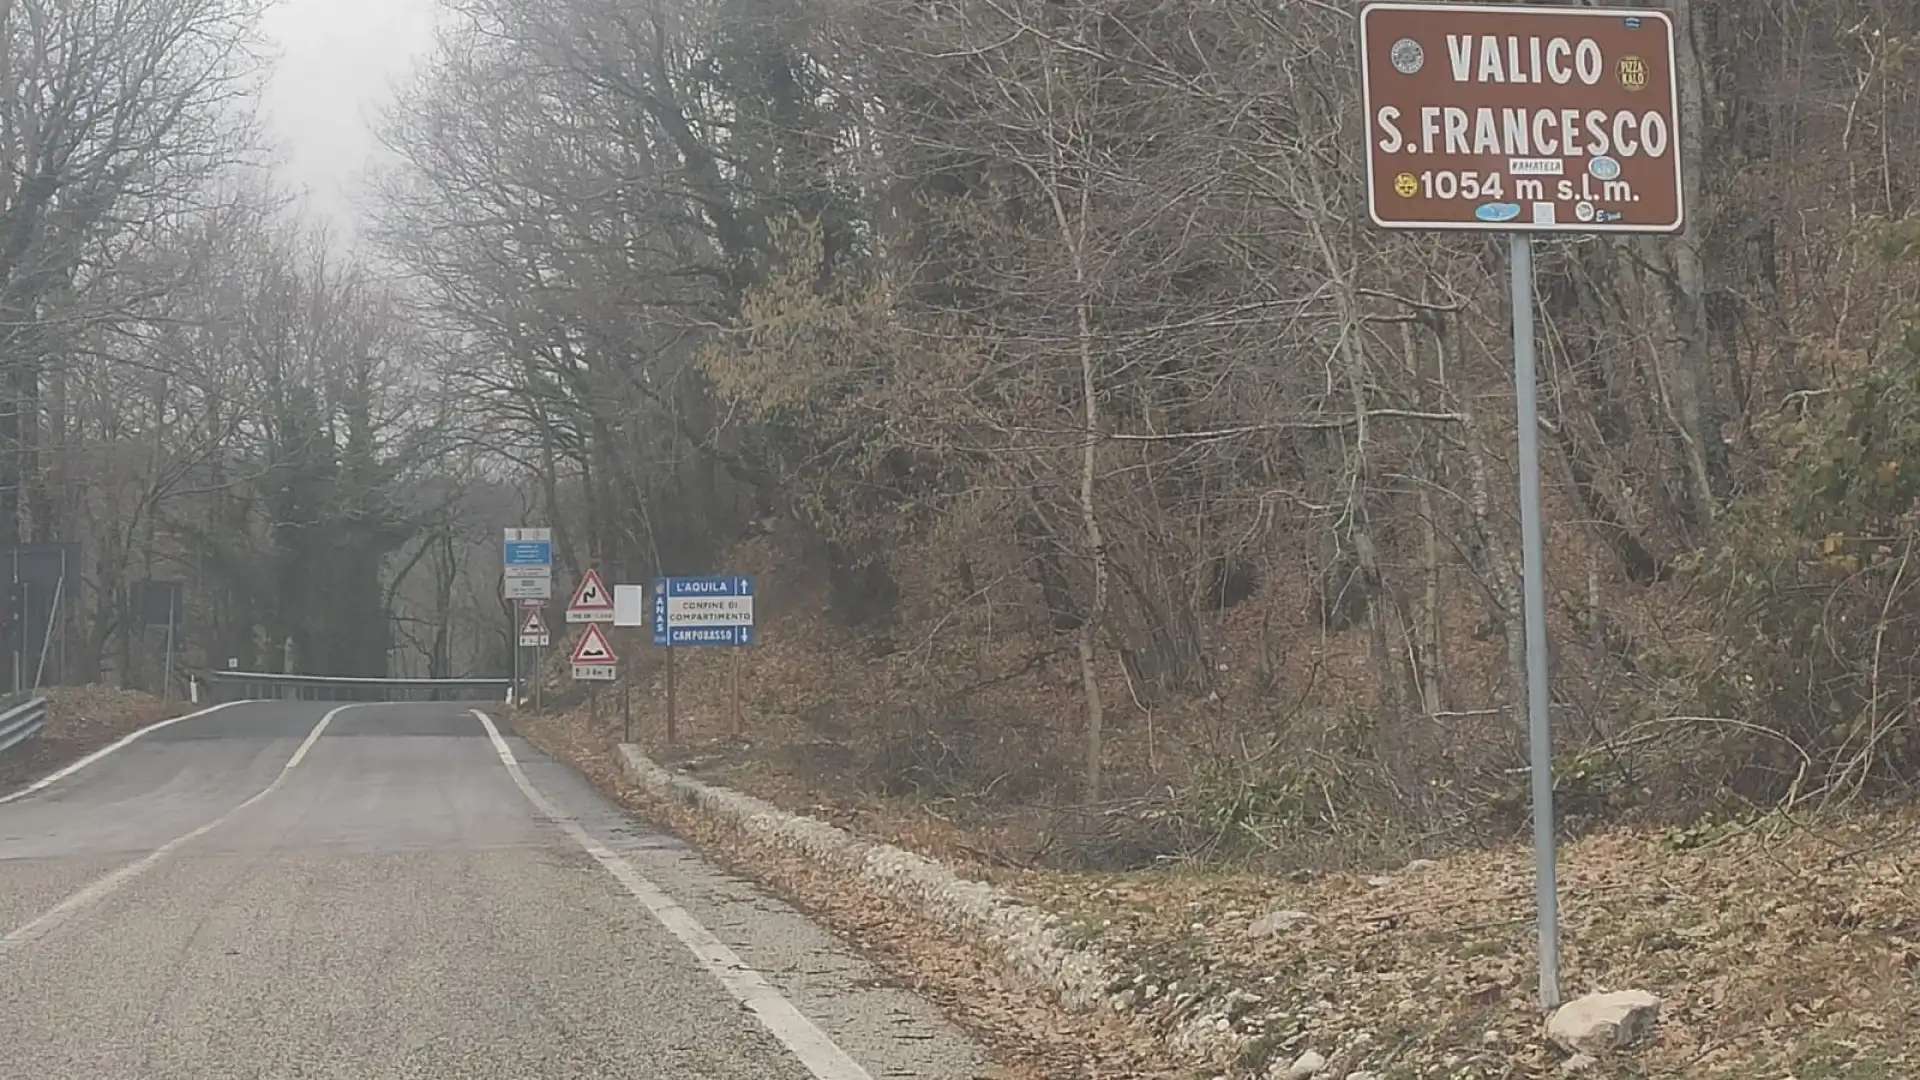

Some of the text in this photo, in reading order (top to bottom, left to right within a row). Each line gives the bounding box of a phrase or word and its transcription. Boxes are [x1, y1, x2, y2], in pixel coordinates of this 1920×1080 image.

[1446, 34, 1603, 85] VALICO
[1621, 60, 1643, 73] PIZZA
[1377, 106, 1668, 158] S.FRANCESCO
[1420, 170, 1640, 202] 1054 m s.l.m.
[676, 582, 728, 593] L'AQUILA
[682, 601, 738, 610] CONFINE DI
[655, 597, 664, 632] ANAS
[670, 612, 751, 622] COMPARTIMENTO
[673, 630, 732, 641] CAMPOBASSO
